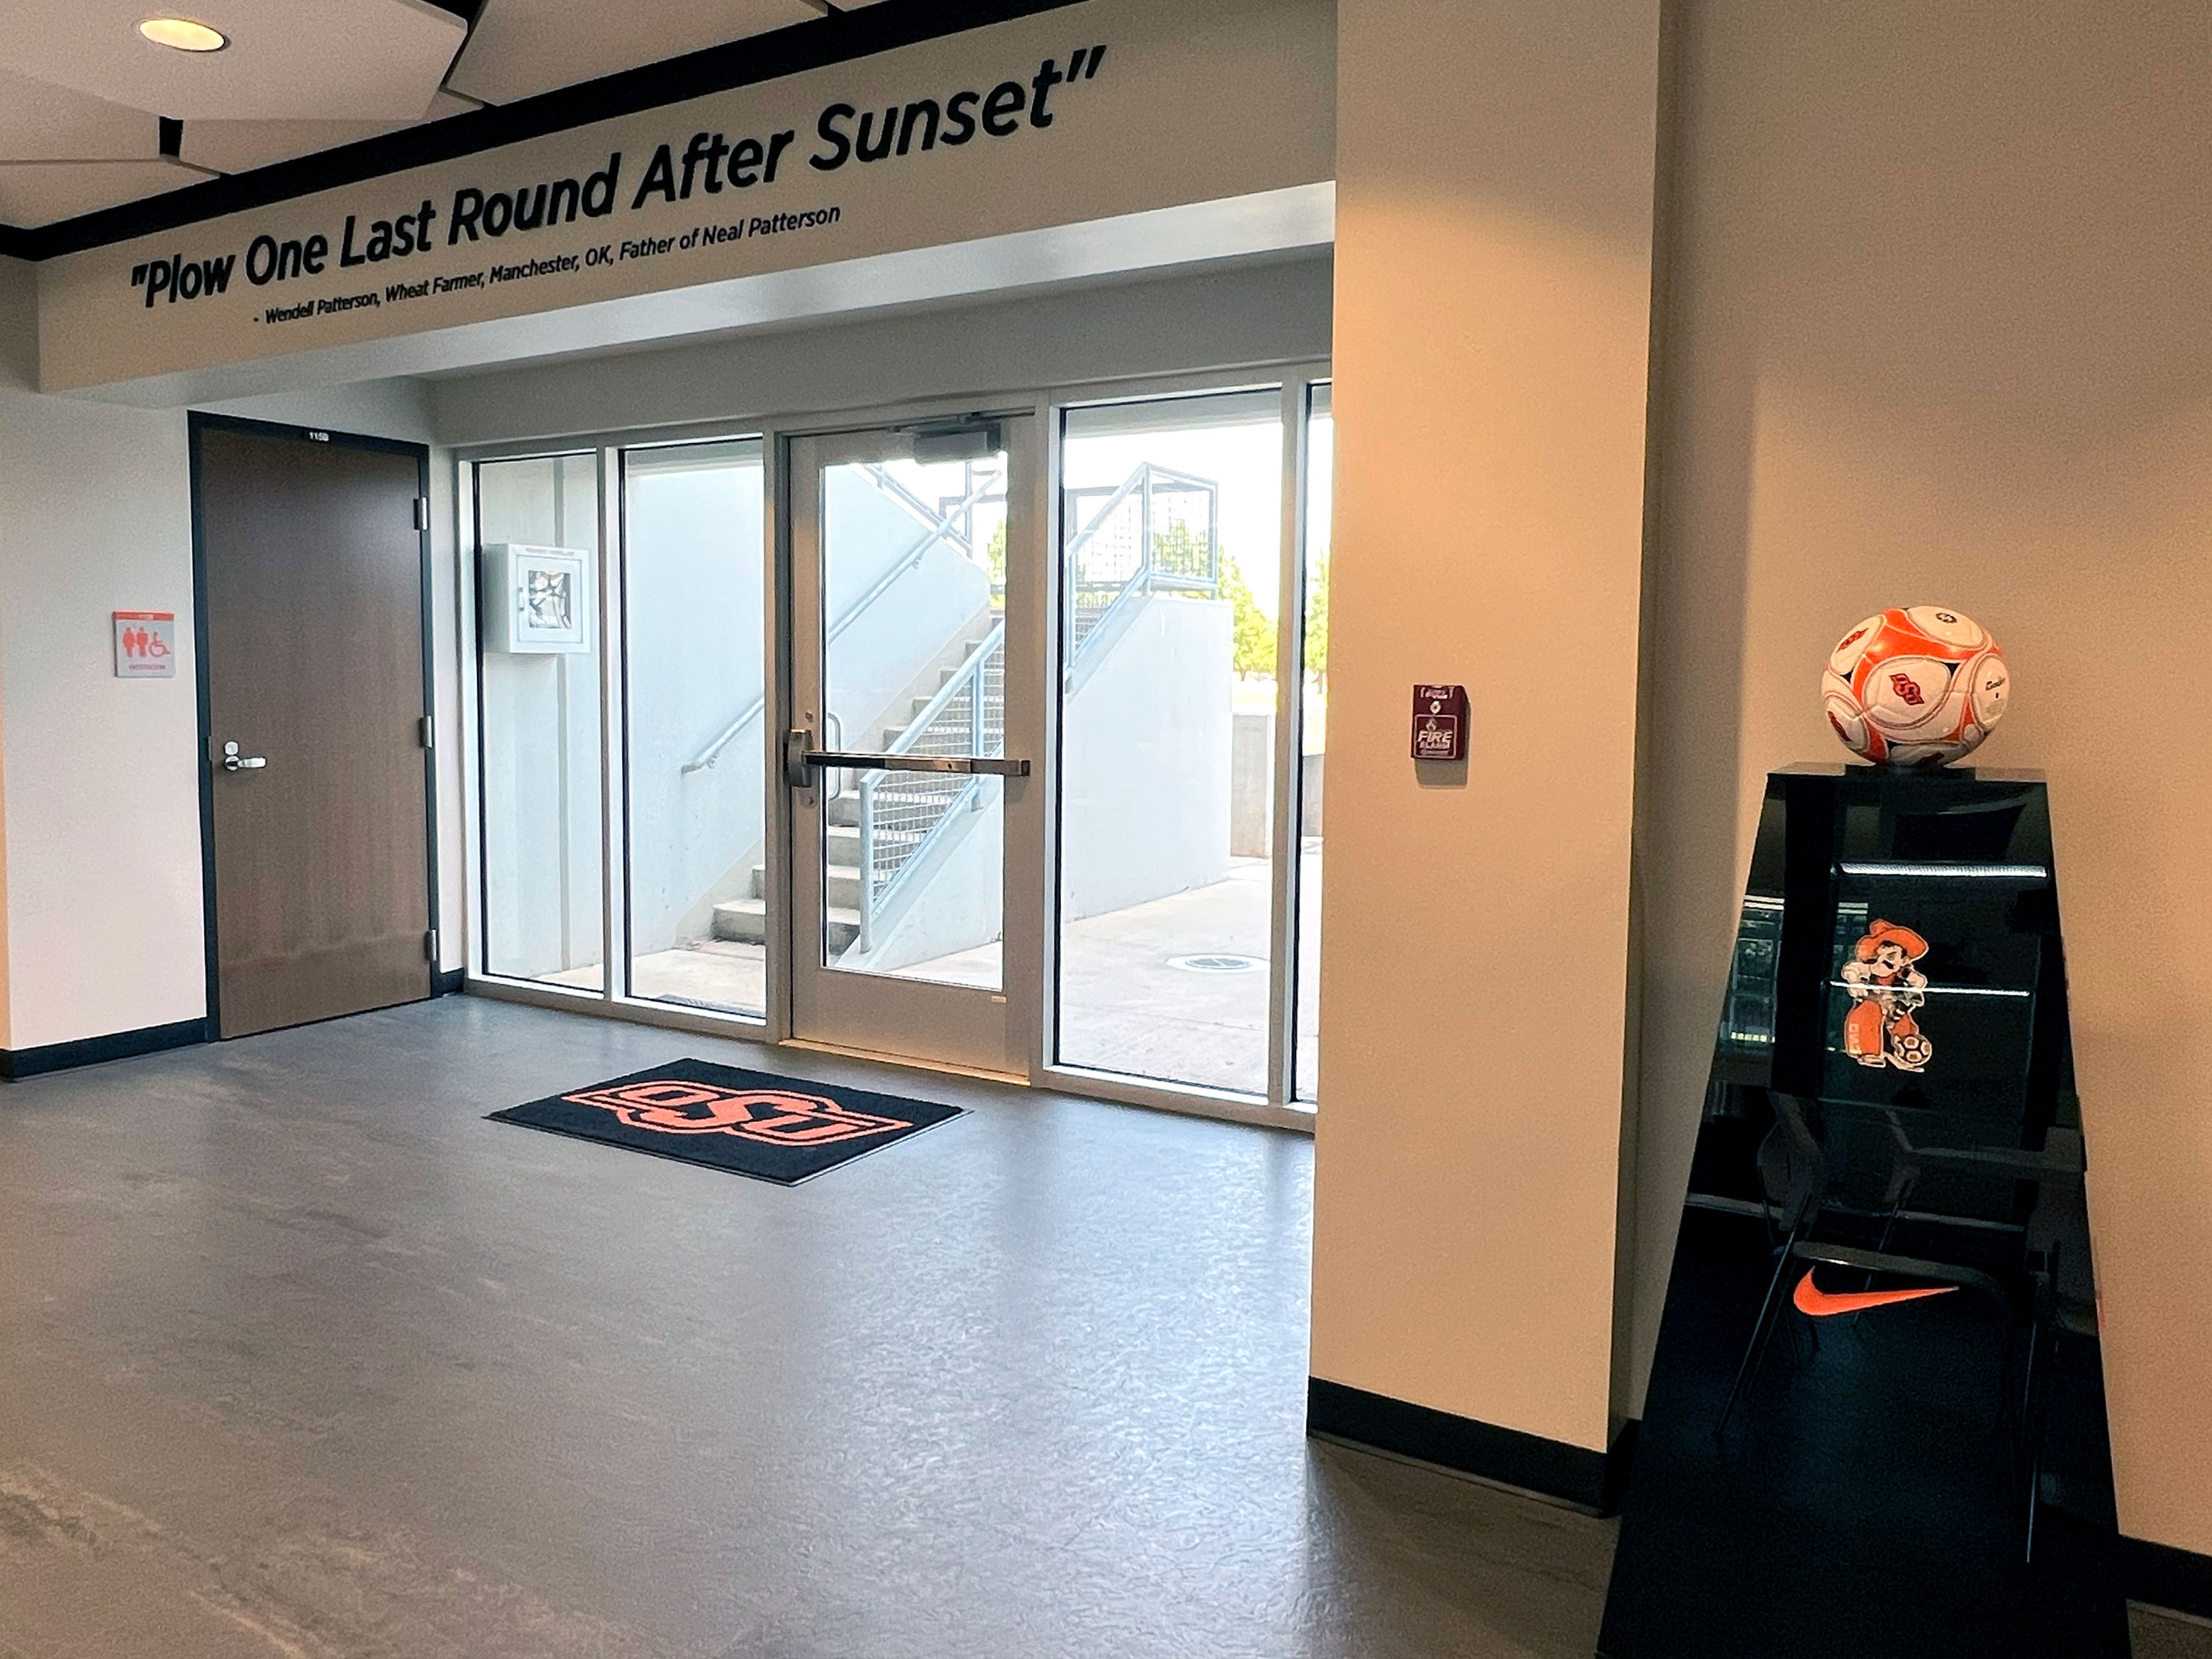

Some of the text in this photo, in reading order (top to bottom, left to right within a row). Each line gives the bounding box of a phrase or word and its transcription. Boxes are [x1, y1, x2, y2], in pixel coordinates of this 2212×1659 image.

[131, 44, 1108, 308] "Plow One Last Round After Sunset"
[265, 300, 315, 324] Wendell
[317, 292, 381, 315] Patterson,
[385, 279, 430, 303] Wheat
[432, 272, 485, 295] Farmer,
[489, 255, 580, 284] Manchester,
[585, 244, 614, 267] OK,
[619, 236, 676, 261] Father
[679, 228, 700, 250] of
[702, 218, 744, 247] Neal
[748, 206, 840, 238] Patterson
[1418, 730, 1453, 743] FIRE
